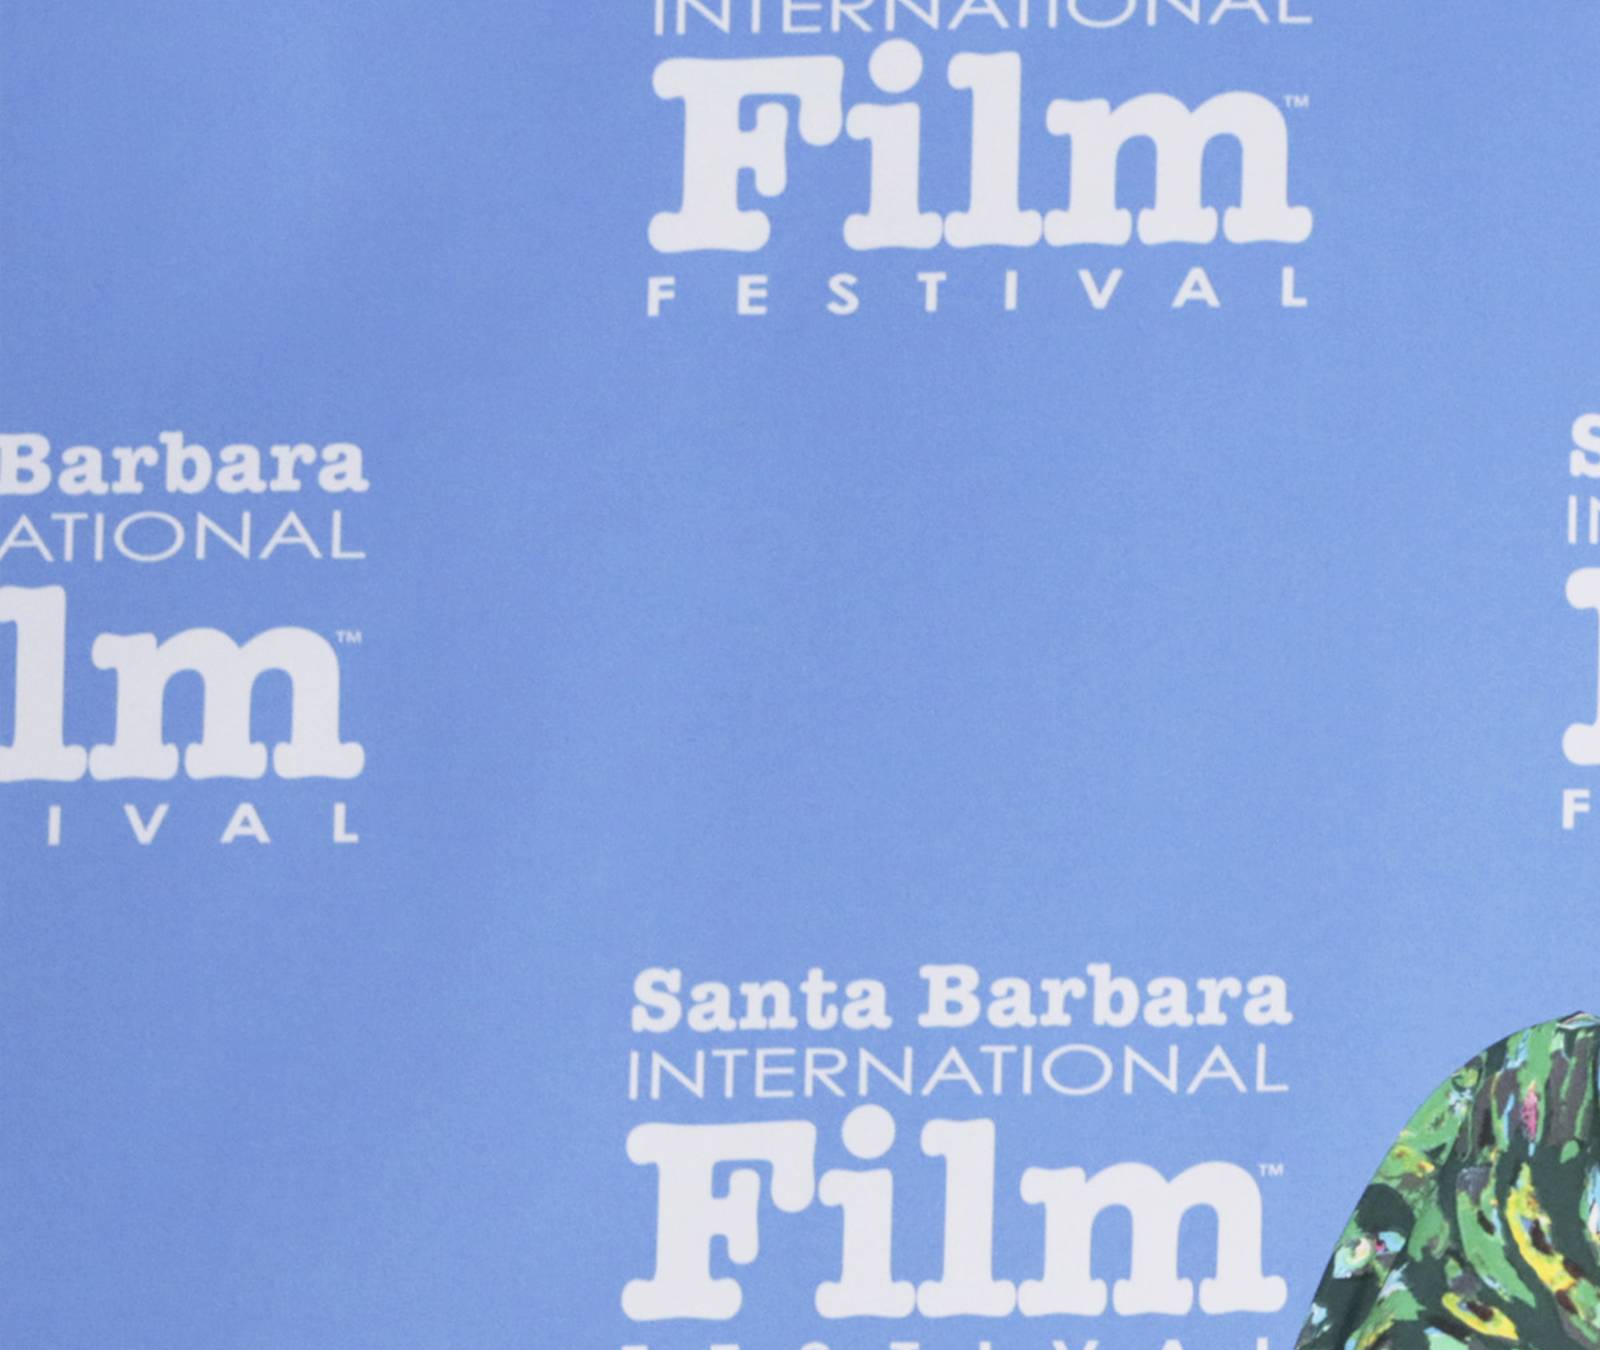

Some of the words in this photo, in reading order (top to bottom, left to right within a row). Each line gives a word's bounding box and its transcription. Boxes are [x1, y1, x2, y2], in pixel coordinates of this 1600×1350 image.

[648, 37, 1314, 253] Film
[646, 265, 1308, 317] FESTIVAL
[0, 430, 370, 496] Barbara
[0, 510, 364, 562] ATIONAL
[0, 584, 366, 783] lm
[47, 802, 359, 846] IVAL
[630, 966, 893, 1034] Santa
[917, 962, 1295, 1029] Barbara
[628, 1042, 1288, 1100] INTERNATIONAL
[620, 1103, 1289, 1322] Film
